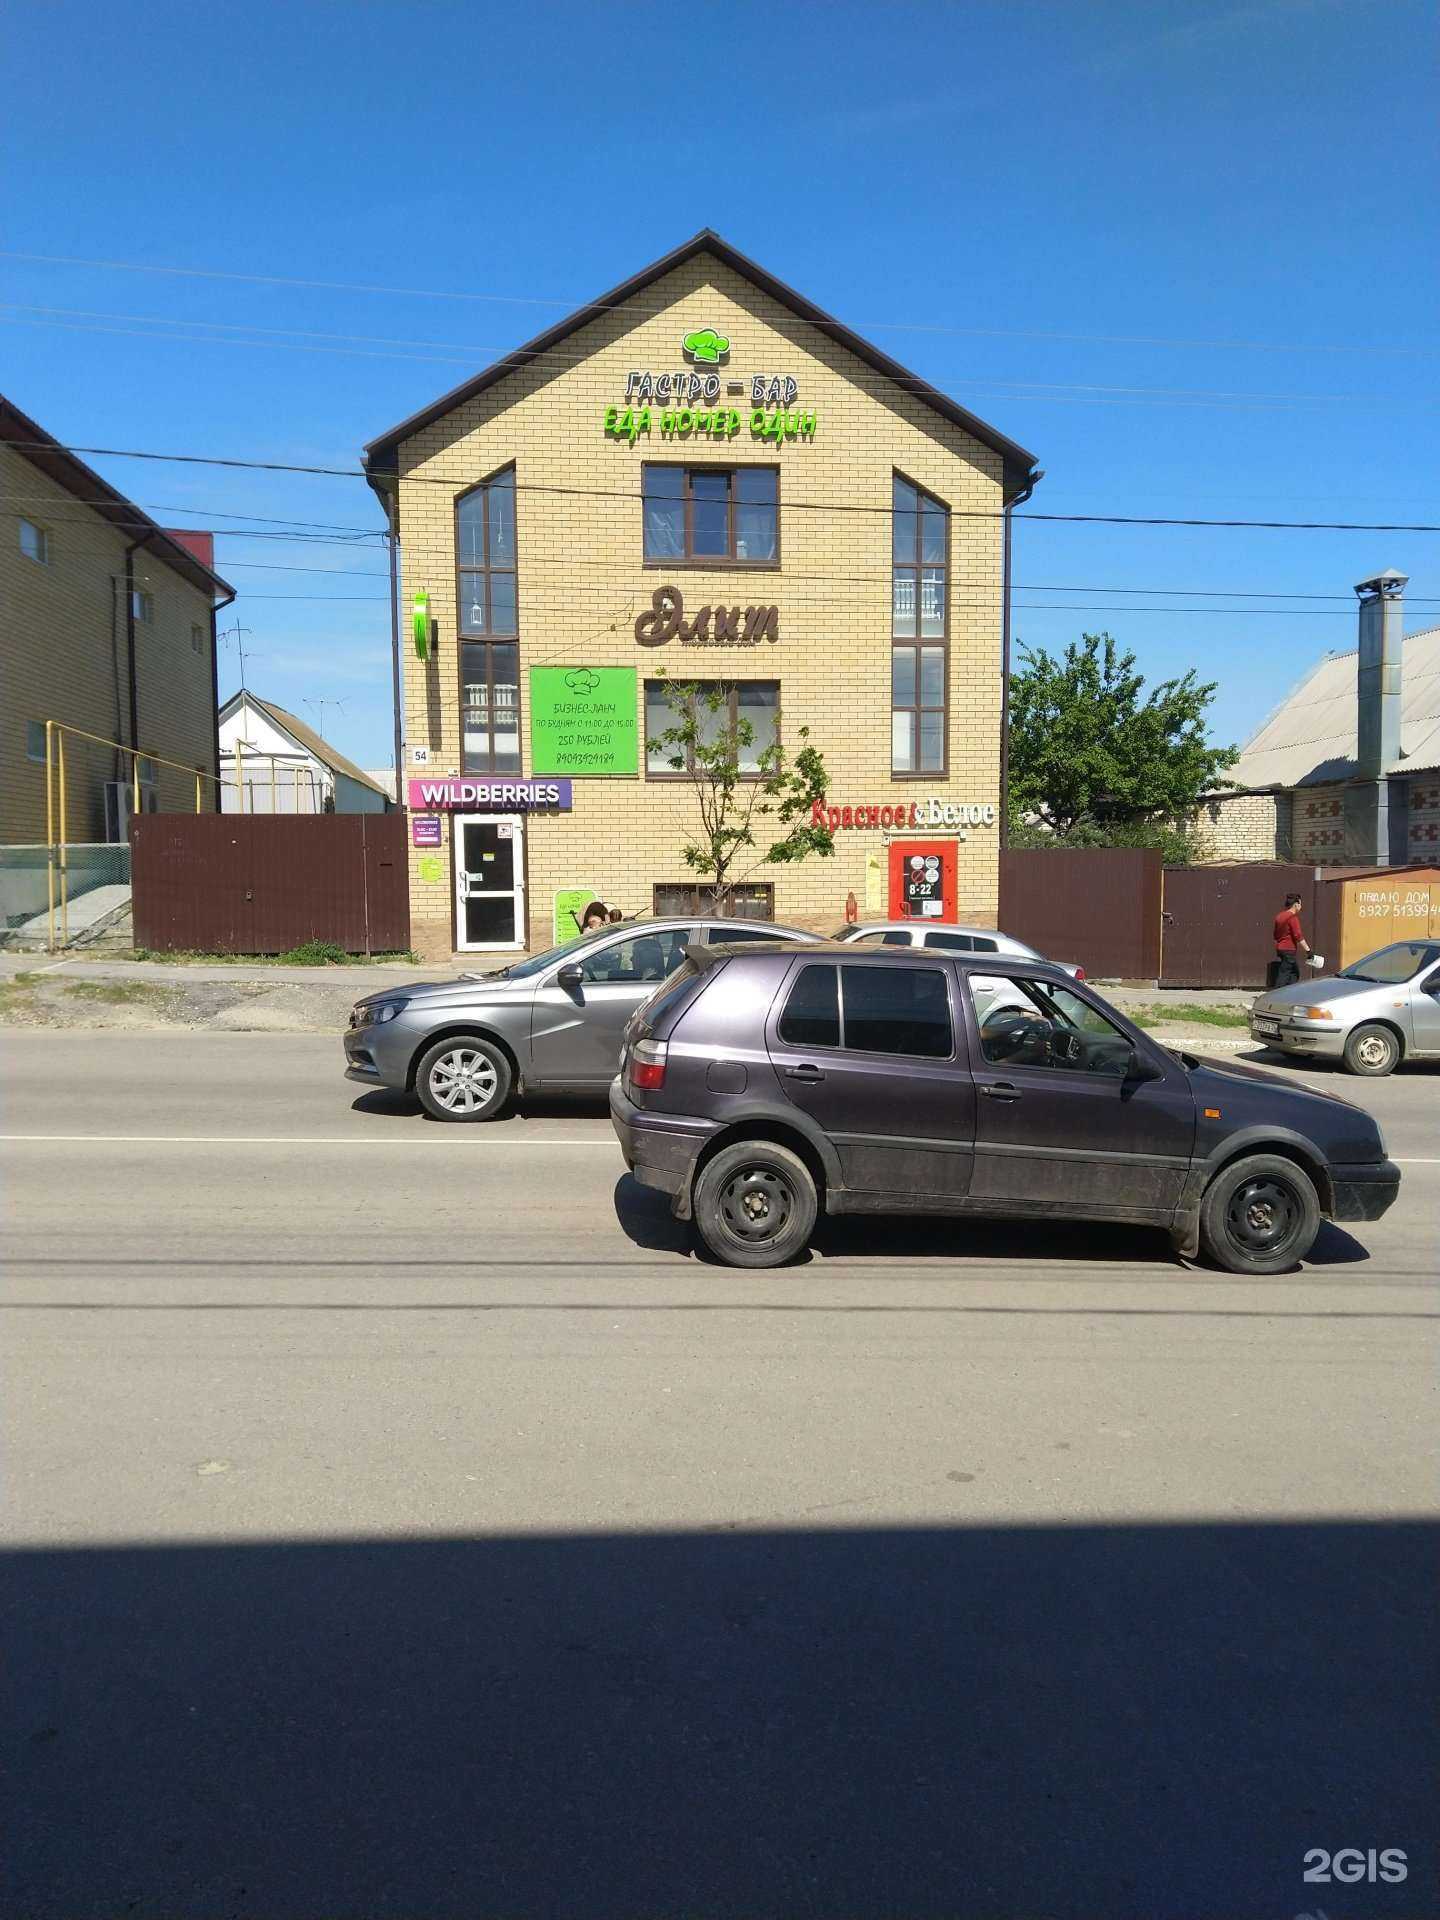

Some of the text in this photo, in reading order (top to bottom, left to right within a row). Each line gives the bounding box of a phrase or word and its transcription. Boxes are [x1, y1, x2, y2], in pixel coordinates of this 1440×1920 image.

[626, 371, 720, 398] ГАСТРО
[751, 374, 798, 401] БАР
[604, 404, 817, 443] ЕДА НОМЕР ОДИН
[635, 585, 779, 647] Элит
[558, 734, 612, 746] 250 РУБЛЕЙ
[415, 751, 427, 761] 54
[421, 784, 560, 802] WILDBERRIES
[1404, 891, 1430, 904] ДОМ
[1359, 904, 1390, 918] 8927
